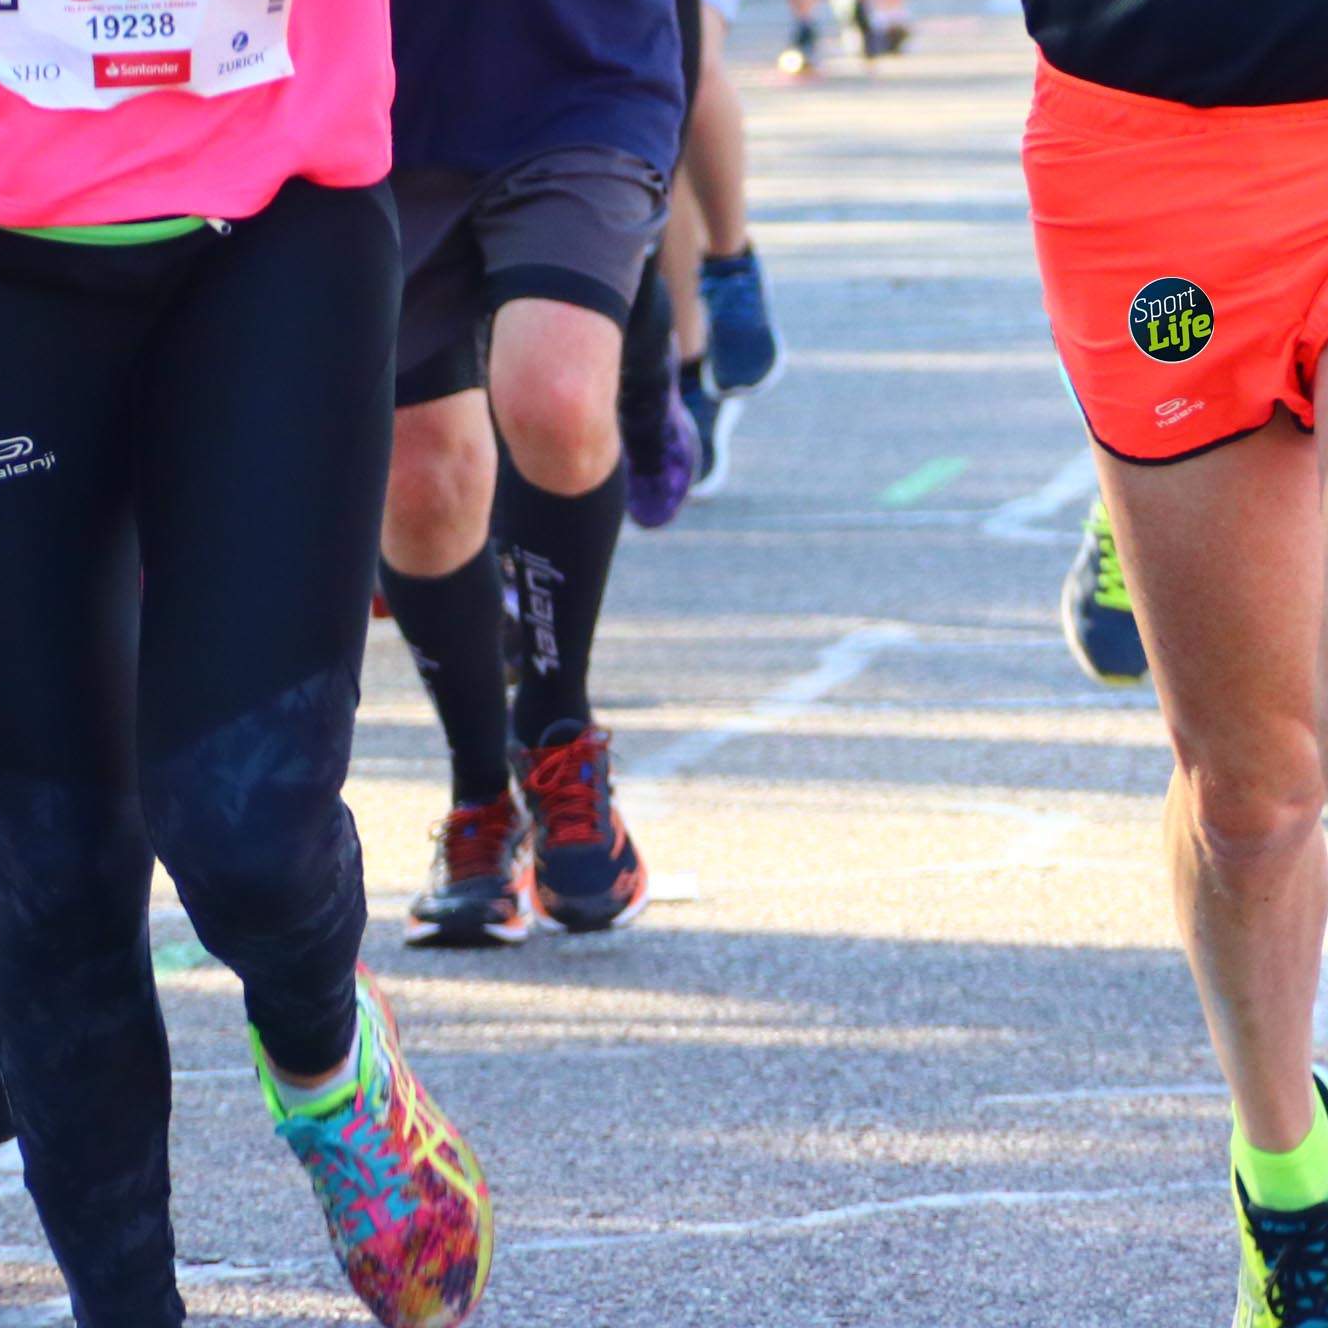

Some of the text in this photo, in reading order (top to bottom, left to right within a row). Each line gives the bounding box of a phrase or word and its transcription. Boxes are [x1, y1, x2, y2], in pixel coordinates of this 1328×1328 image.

[86, 12, 176, 41] 19238
[121, 62, 179, 74] Santander
[218, 52, 265, 75] ZURICH
[1134, 286, 1197, 324] Sport
[1147, 309, 1212, 352] Life
